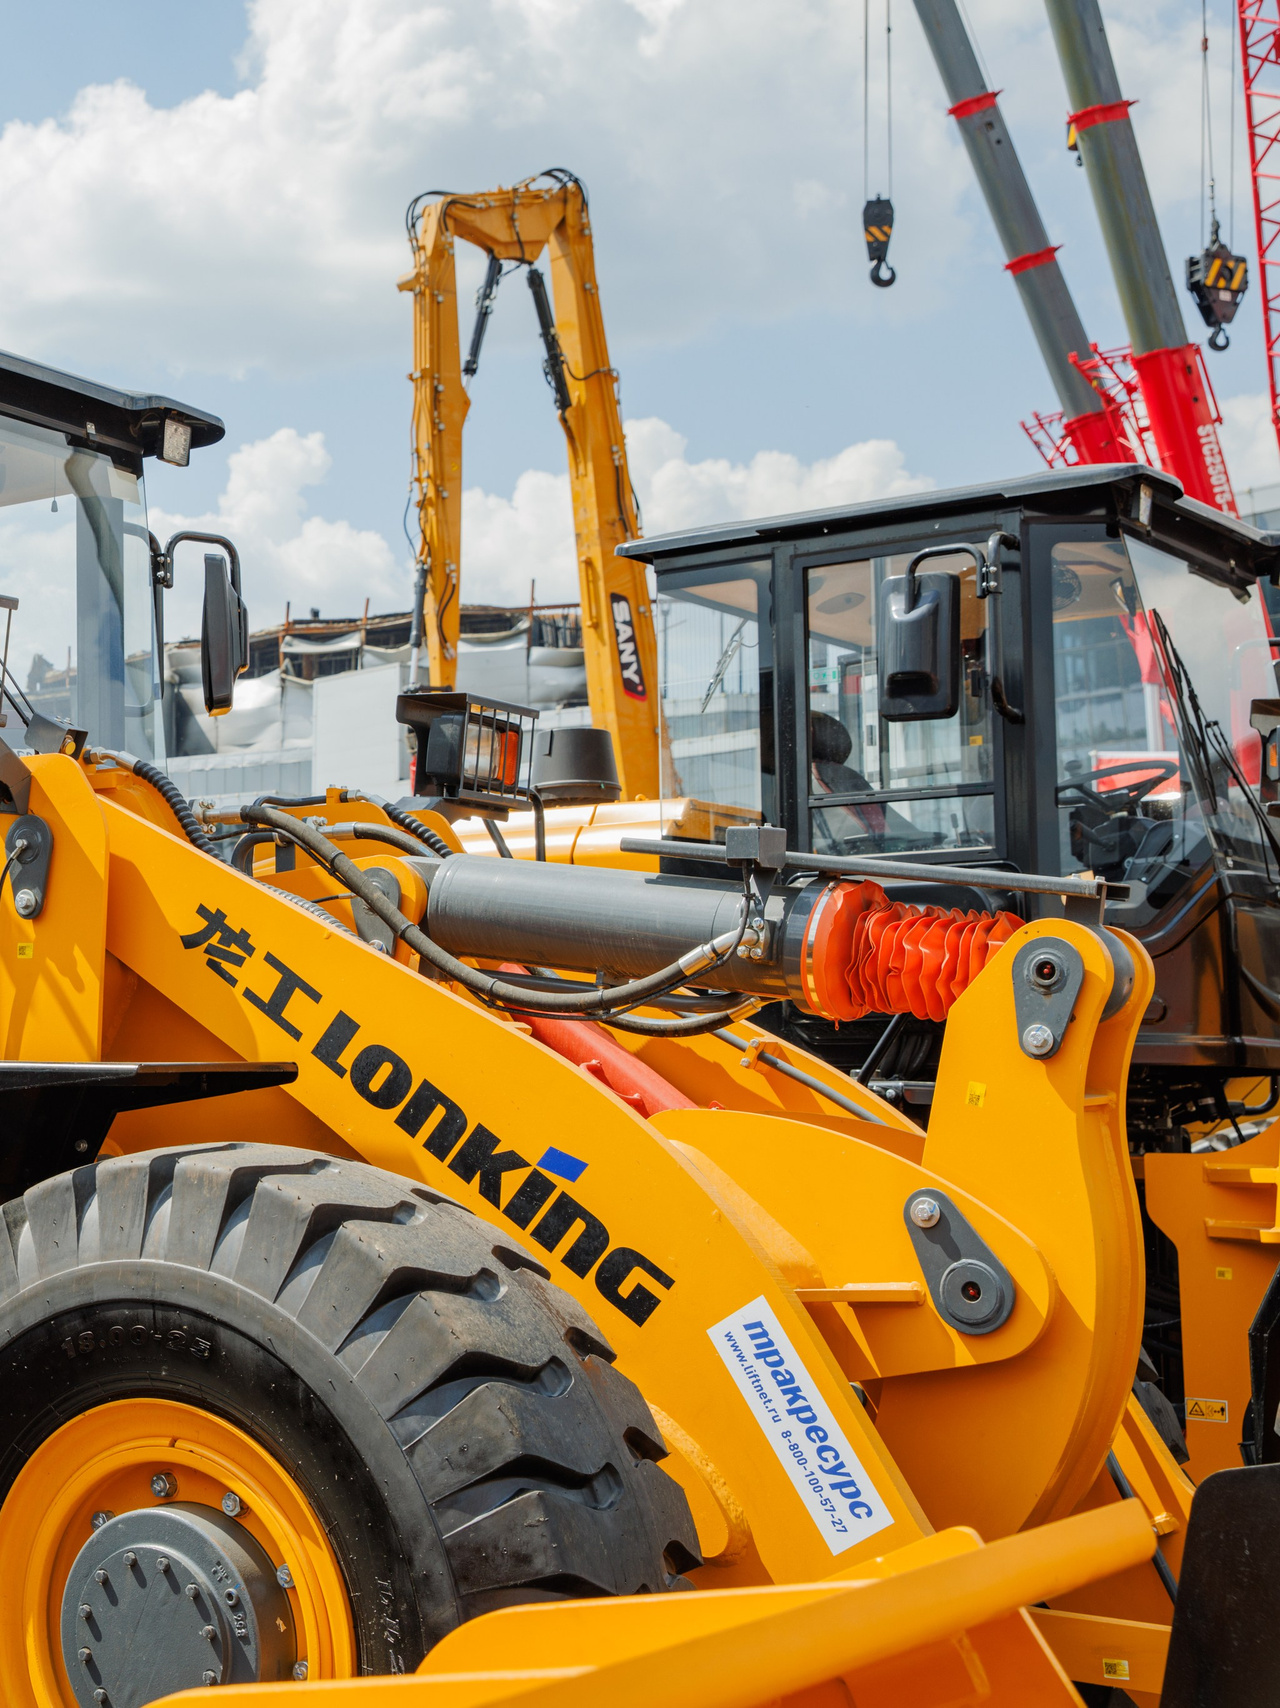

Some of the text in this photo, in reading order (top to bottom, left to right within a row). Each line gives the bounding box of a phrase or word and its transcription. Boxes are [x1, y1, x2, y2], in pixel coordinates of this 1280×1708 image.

[612, 600, 640, 684] SANY
[61, 1325, 213, 1360] 18.00-25
[724, 1331, 848, 1534] www.liftnet.ru 8-800-100-57-27
[742, 1320, 873, 1519] тракресурс
